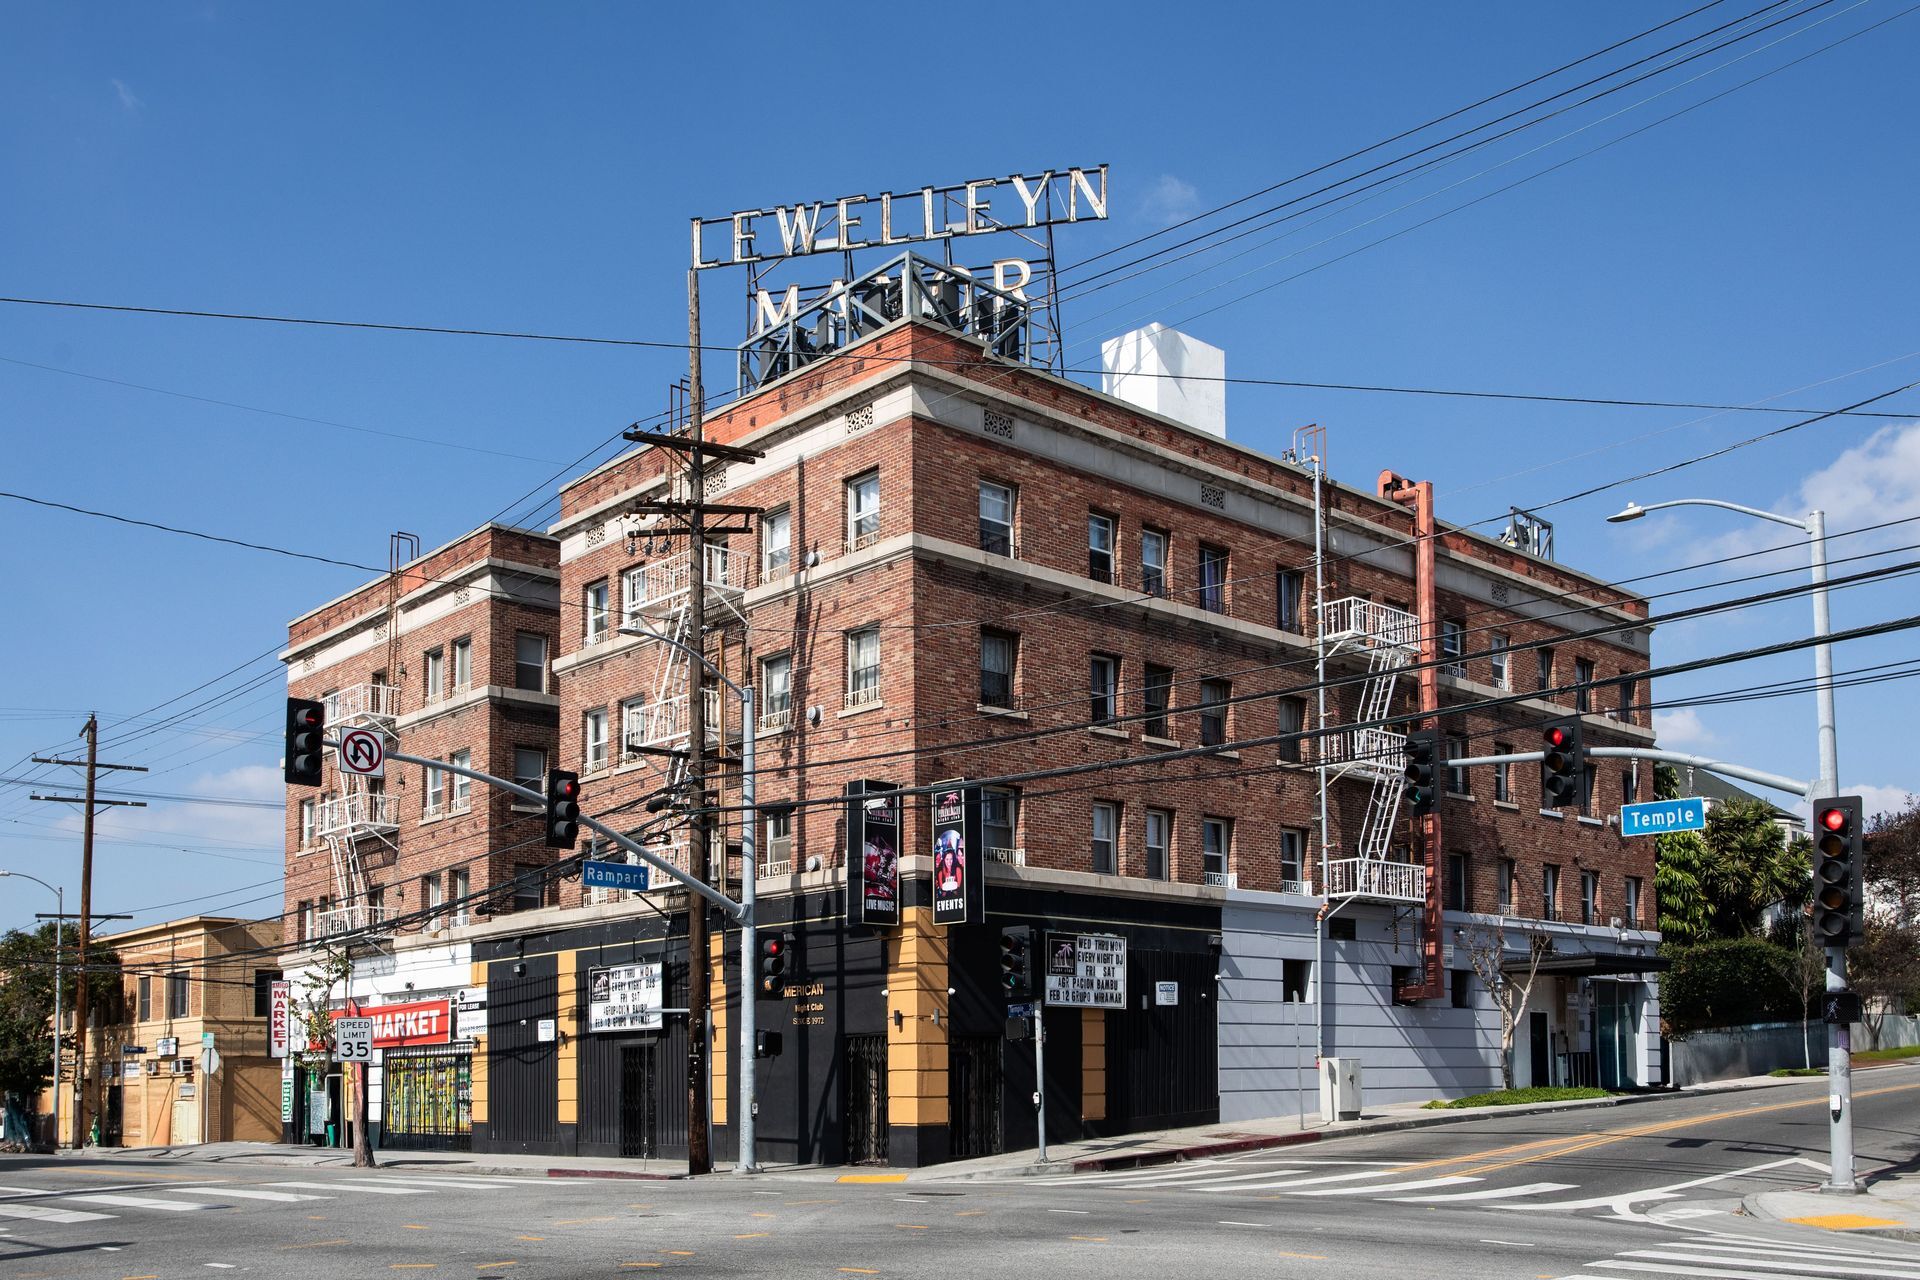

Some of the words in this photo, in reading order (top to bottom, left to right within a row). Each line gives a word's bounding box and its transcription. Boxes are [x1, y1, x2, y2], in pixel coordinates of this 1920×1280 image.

[690, 164, 1109, 269] LEWELLEYN
[757, 257, 1028, 341] MAOR
[1631, 808, 1694, 827] Temple
[587, 867, 645, 884] Rampart
[866, 899, 877, 910] LIVE
[877, 900, 894, 911] MUSIC
[937, 898, 963, 911] EVENTS
[1078, 939, 1091, 949] WED
[1095, 940, 1109, 951] THRU
[1110, 941, 1122, 952] MON
[1078, 951, 1095, 963] EVERY
[1097, 953, 1113, 964] NIGHT
[1086, 966, 1095, 976] FRI
[1103, 967, 1115, 977] SAT
[1097, 979, 1118, 990] BAMBU
[1050, 990, 1060, 1000] FEB
[1062, 990, 1069, 1001] 12
[1072, 991, 1090, 1002] GRUPO
[1094, 992, 1122, 1004] MIRAMAR
[459, 1003, 467, 1011] FOR
[468, 1002, 480, 1010] LEASE
[810, 1002, 823, 1011] Club
[274, 990, 286, 1048] MARKET
[372, 1009, 440, 1039] MARKET
[343, 1031, 366, 1039] LIMIT
[341, 1041, 368, 1058] 35
